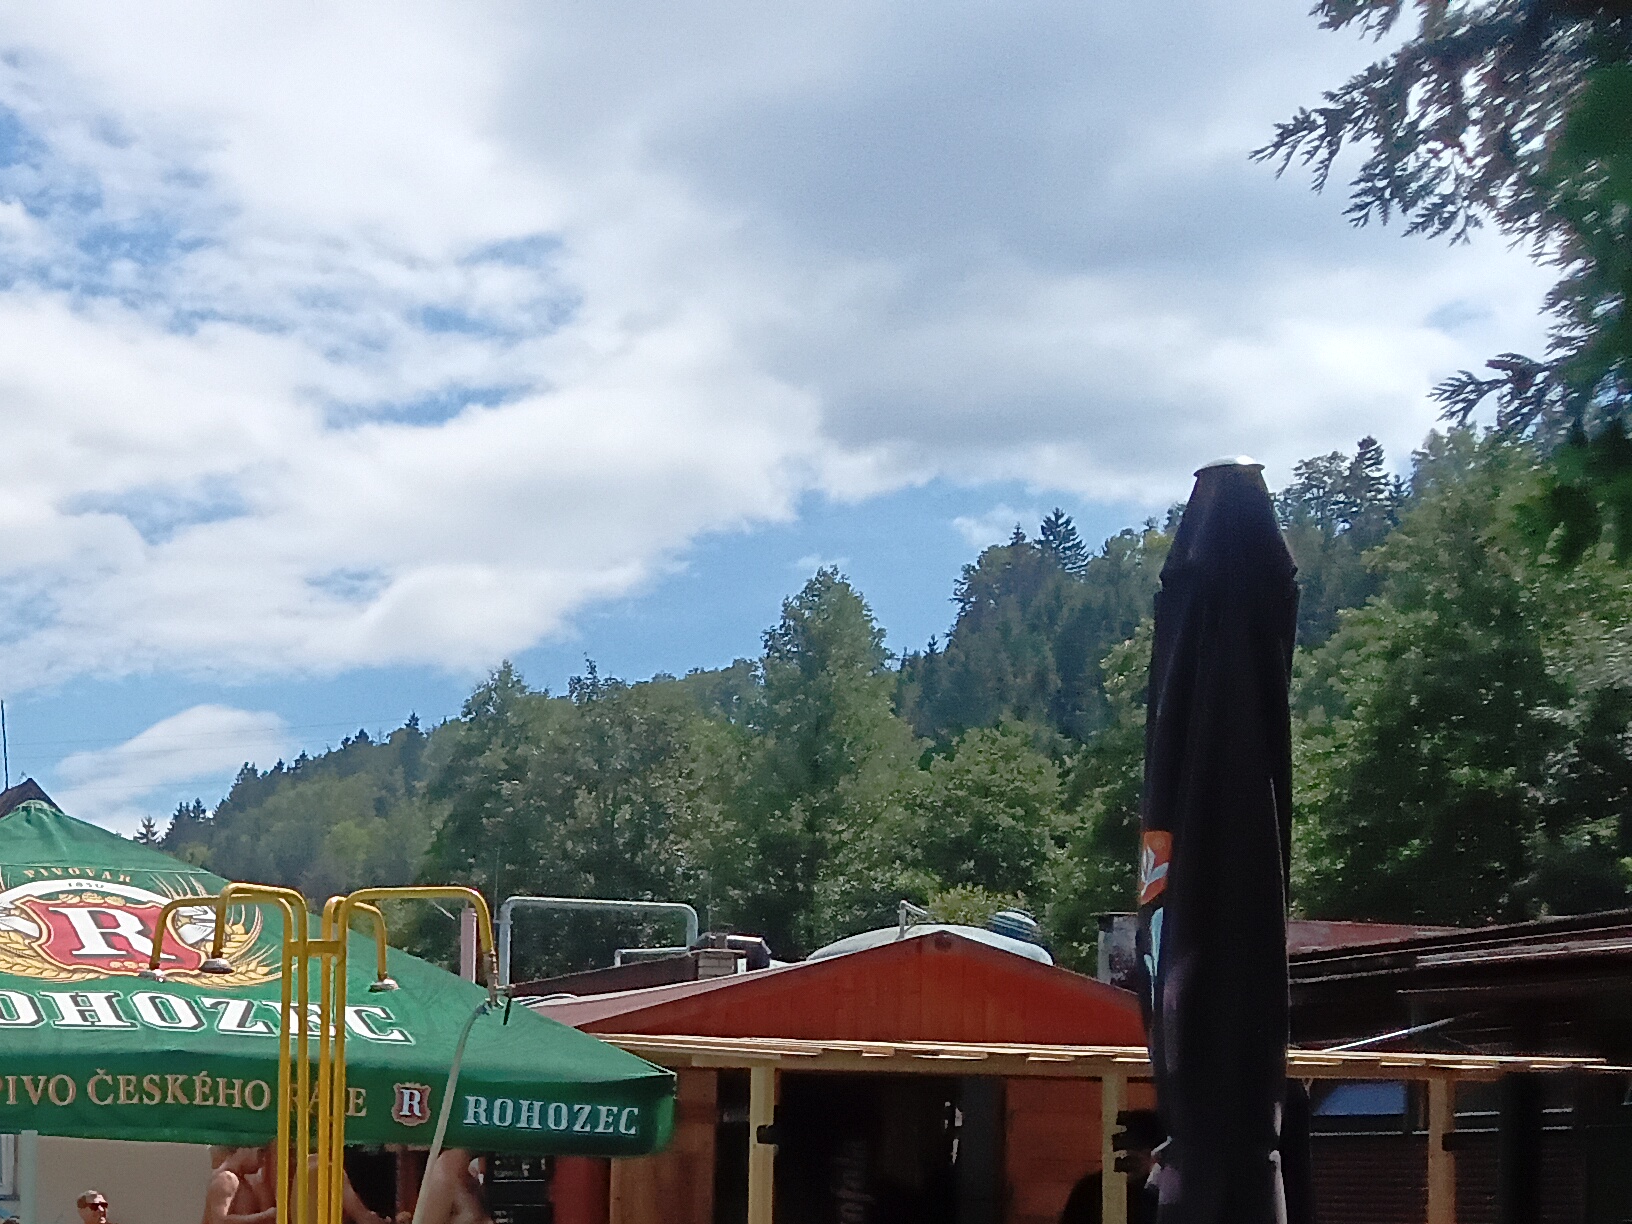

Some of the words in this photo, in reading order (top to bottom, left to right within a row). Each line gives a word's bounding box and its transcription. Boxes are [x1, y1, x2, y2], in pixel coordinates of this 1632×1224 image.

[23, 866, 131, 883] PIVOVAR
[48, 906, 177, 960] R
[86, 1067, 272, 1111] ČESKÉHO
[398, 1087, 423, 1118] R
[462, 1094, 640, 1136] ROHOZEC
